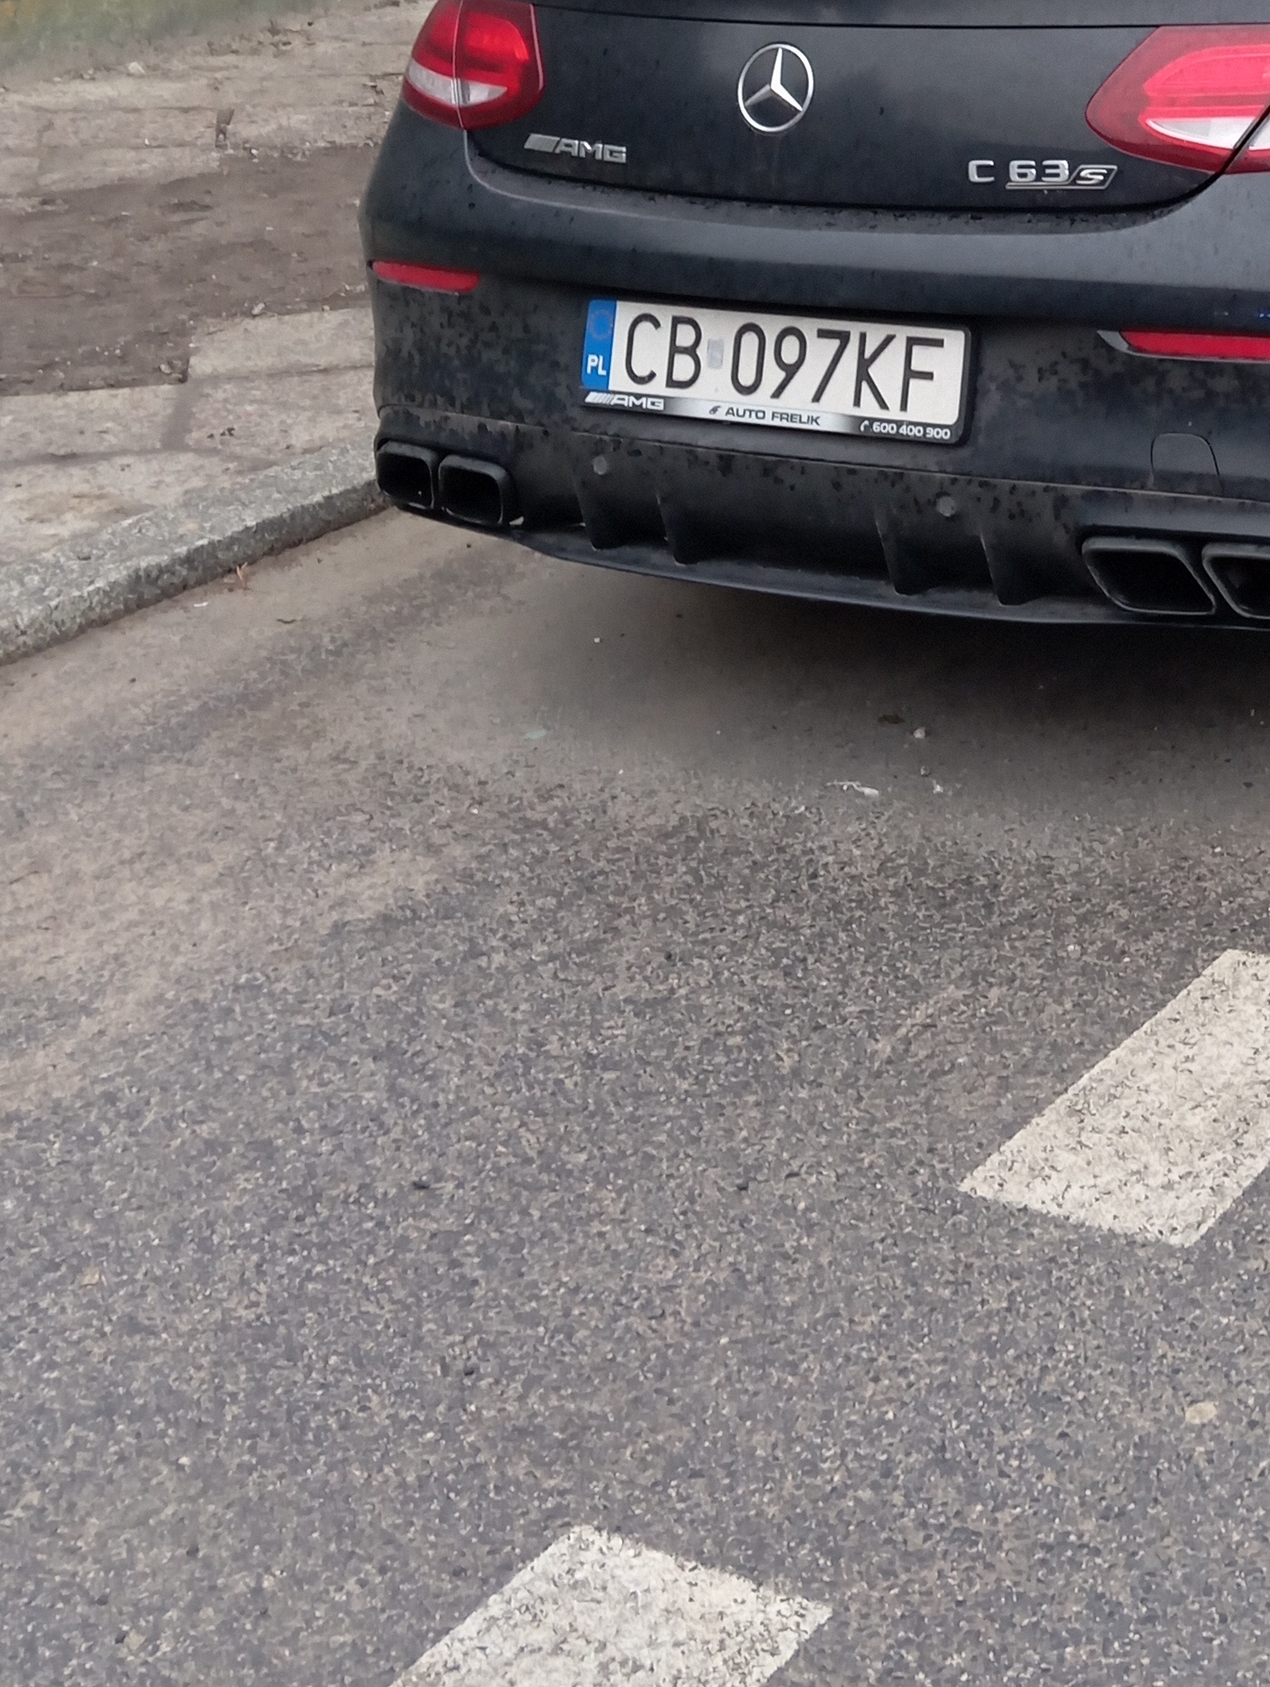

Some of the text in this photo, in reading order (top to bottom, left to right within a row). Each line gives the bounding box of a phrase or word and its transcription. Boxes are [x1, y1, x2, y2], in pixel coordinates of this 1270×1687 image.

[557, 138, 627, 164] AMG
[968, 160, 995, 183] C
[586, 354, 607, 377] PL
[625, 313, 945, 412] CB 097KF
[611, 394, 665, 411] AMG
[725, 407, 821, 426] AUTO FRELIK
[872, 421, 951, 440] 600 400 900
